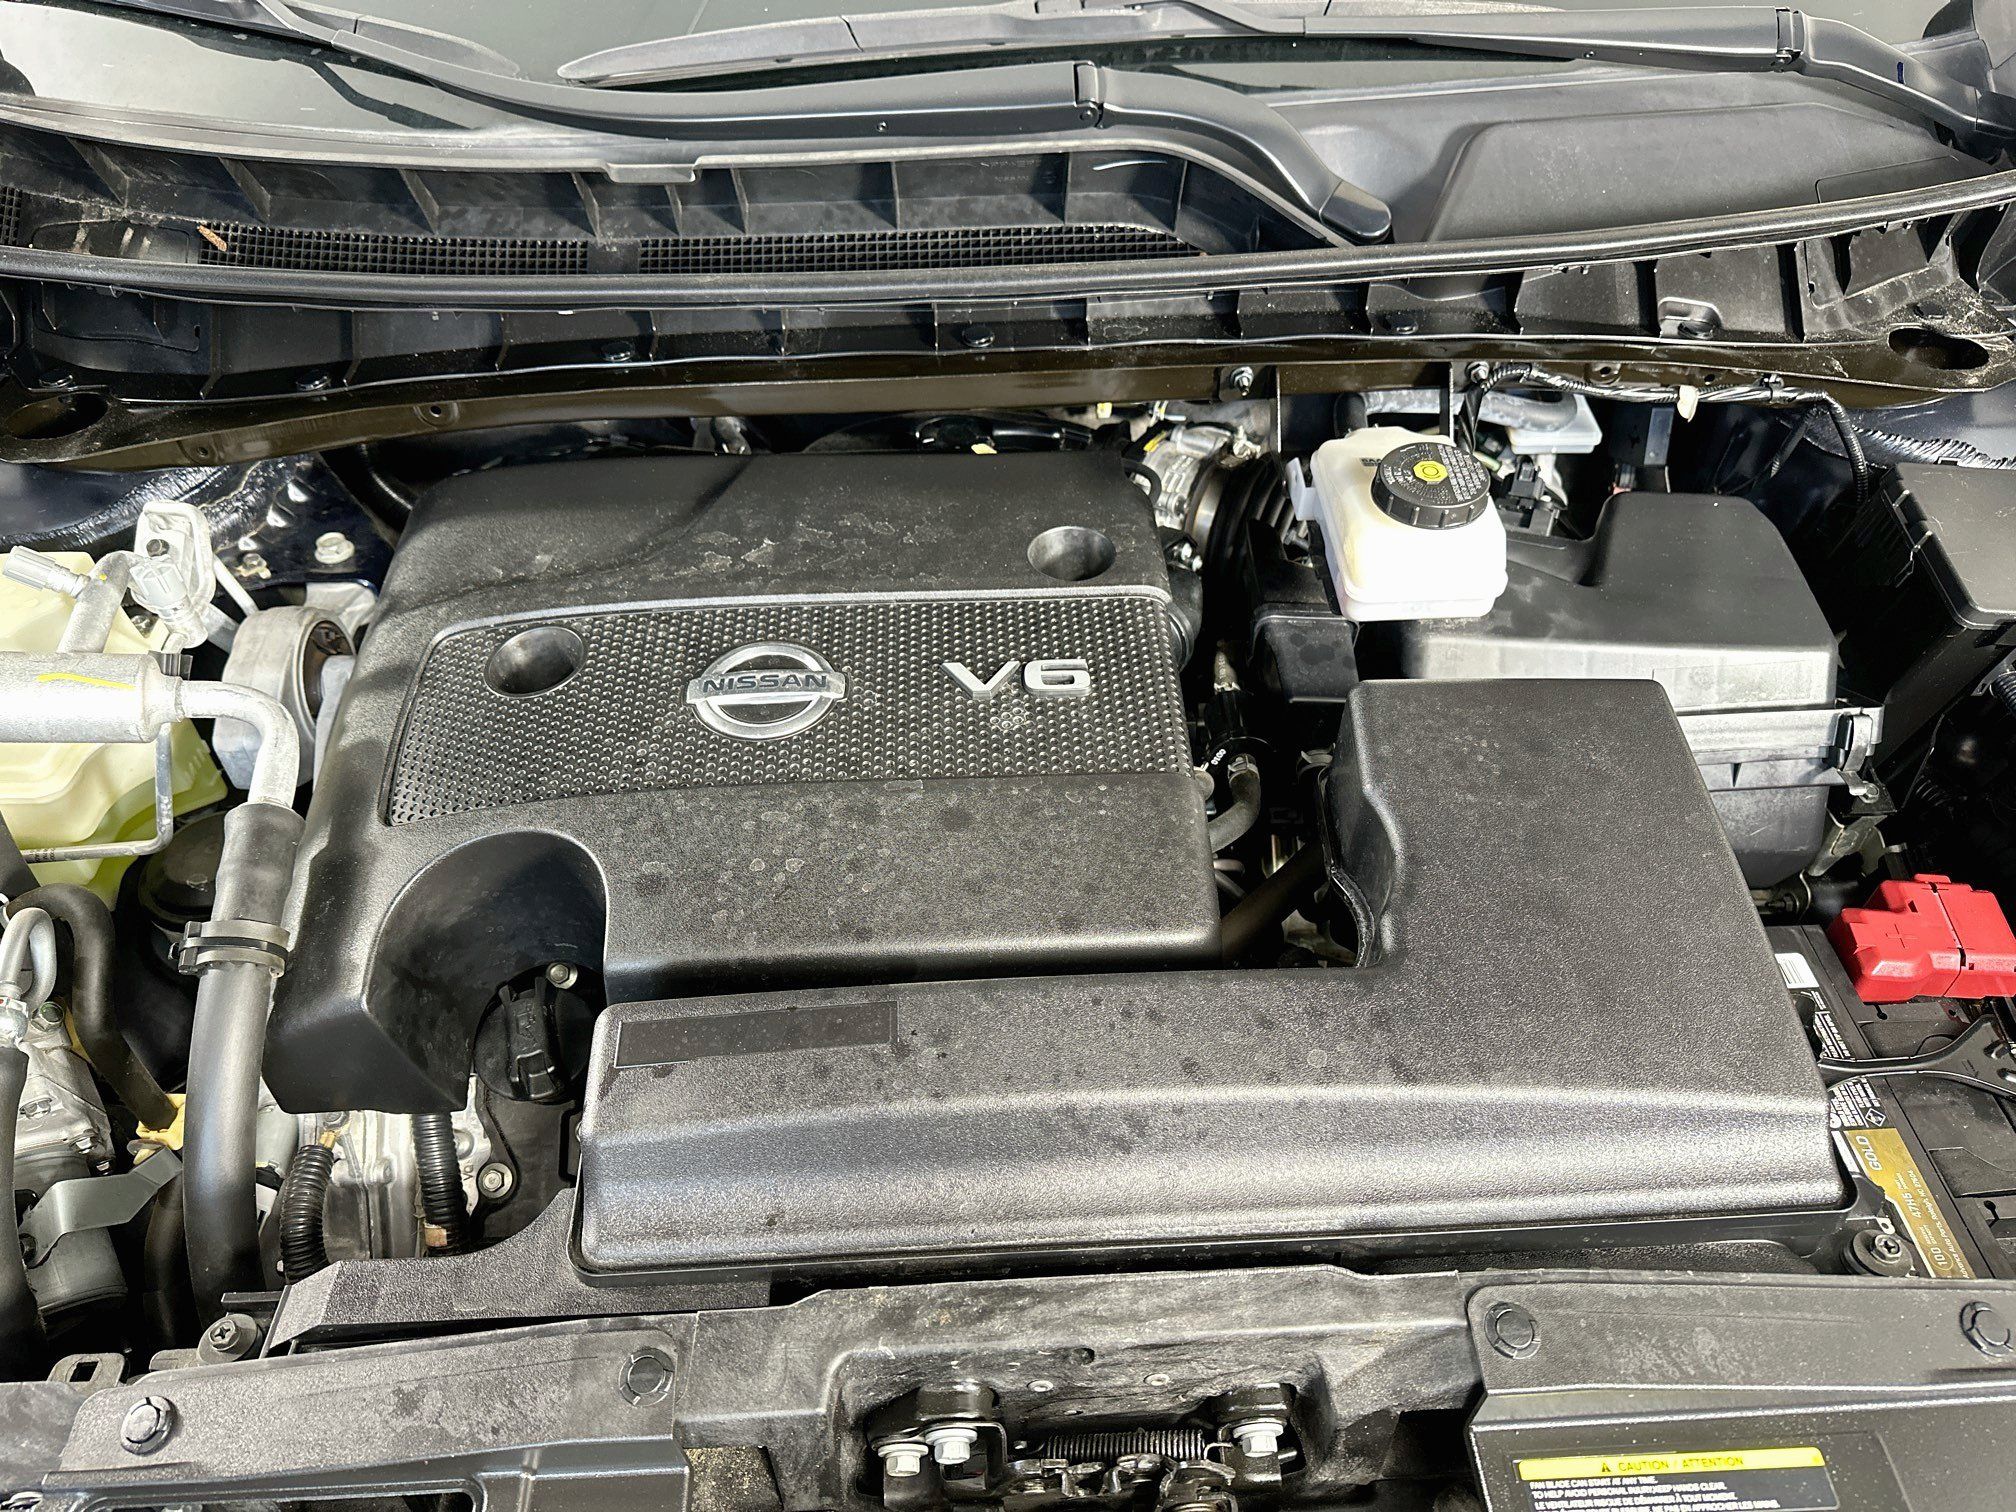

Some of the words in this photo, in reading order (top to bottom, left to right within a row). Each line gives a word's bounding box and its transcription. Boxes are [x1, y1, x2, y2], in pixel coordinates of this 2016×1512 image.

[703, 673, 828, 692] NISSAN
[940, 658, 1092, 701] V6
[1855, 1135, 1883, 1171] GOLD
[1944, 1238, 1955, 1252] Auto
[1931, 1247, 1948, 1267] 100
[1618, 1460, 1669, 1472] CAUTION
[1682, 1457, 1743, 1468] ATTENTION
[1571, 1479, 1587, 1488] CAN
[1532, 1491, 1543, 1499] TO
[1544, 1490, 1564, 1499] HELP
[1534, 1502, 1545, 1511] LE
